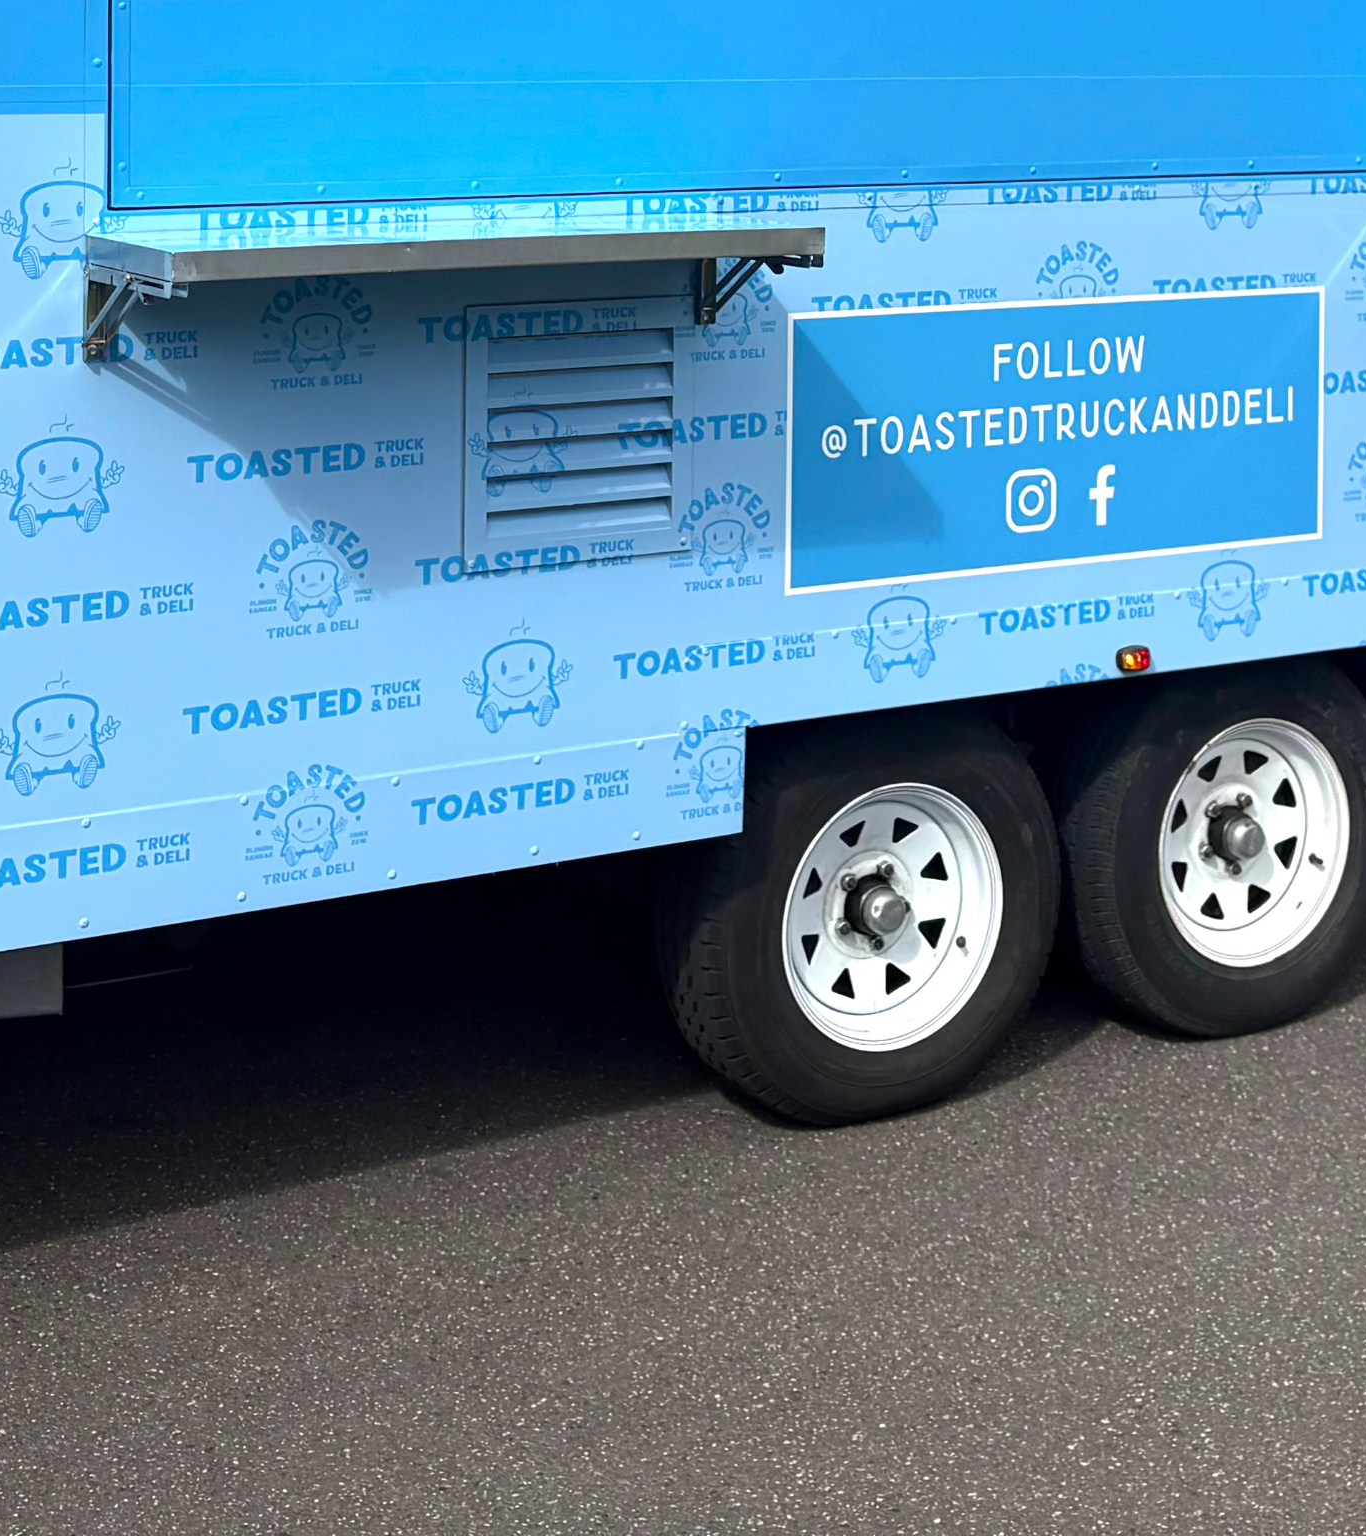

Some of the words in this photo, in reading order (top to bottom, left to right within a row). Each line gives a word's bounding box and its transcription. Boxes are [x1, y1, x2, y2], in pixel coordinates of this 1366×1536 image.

[1036, 241, 1118, 285] TOASTED
[260, 273, 372, 325] TOASTED
[144, 329, 198, 345] TRUCK
[418, 309, 584, 344] TOASTED
[162, 345, 198, 360] DELI
[994, 336, 1144, 381] FOLLOW
[822, 386, 1293, 458] @TOASTEDTRUCKANDDELI
[375, 438, 424, 452] TRUCK
[187, 443, 365, 483] TOASTED
[391, 453, 424, 467] DELI
[678, 483, 770, 533] TOASTED
[256, 520, 369, 574] TOASTED
[588, 539, 634, 554] TRUCK
[415, 545, 581, 585] TOASTED
[140, 583, 193, 599] TRUCK
[140, 603, 151, 616] &
[157, 598, 193, 614] DELI
[978, 599, 1111, 635] TOASTED
[266, 624, 312, 639] TRUCK
[330, 619, 359, 632] DELI
[613, 639, 765, 679] TOASTED
[371, 679, 420, 696] TRUCK
[183, 688, 362, 734] TOASTED
[387, 694, 420, 710] DELI
[584, 769, 628, 785] TRUCK
[253, 764, 365, 821] TOASTED
[411, 776, 575, 825] TOASTED
[598, 783, 629, 799] DELI
[137, 833, 190, 851] TRUCK
[136, 855, 148, 868] &
[154, 848, 190, 865] DELI
[262, 869, 308, 885] TRUCK
[326, 862, 355, 876] DELI
